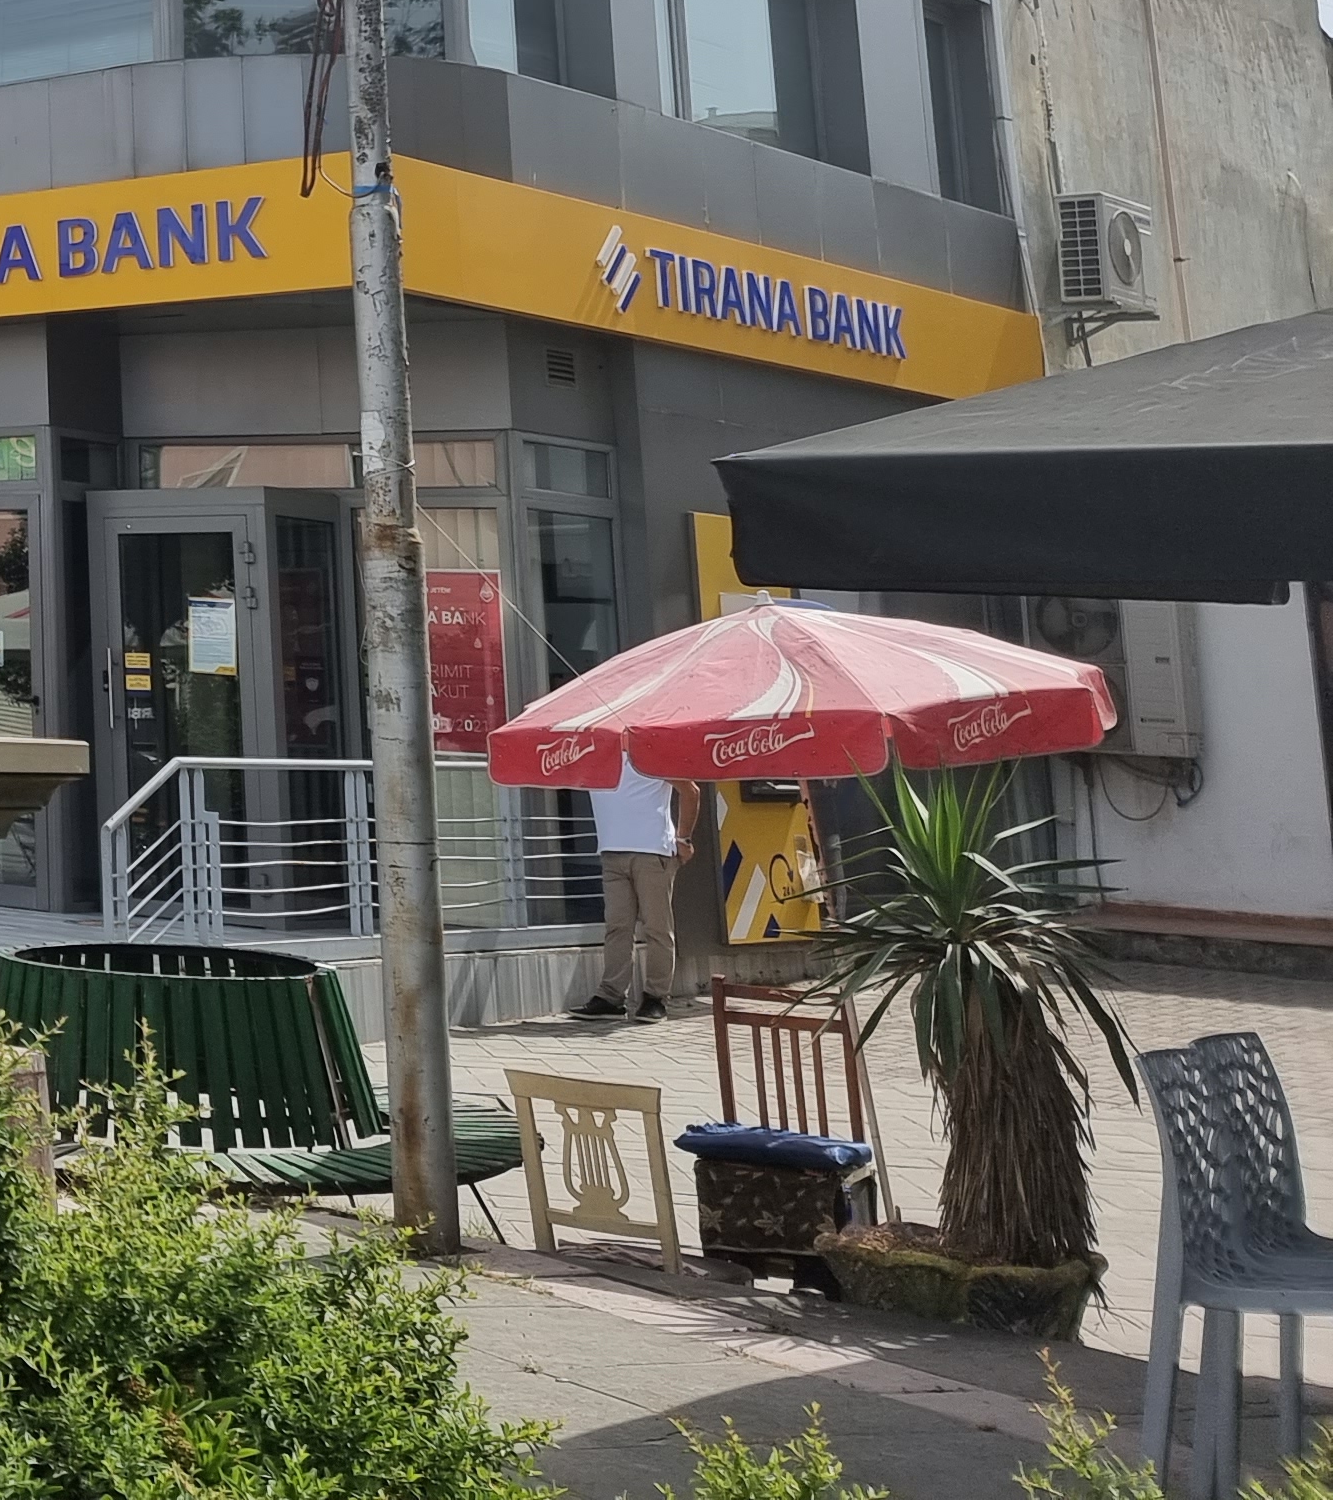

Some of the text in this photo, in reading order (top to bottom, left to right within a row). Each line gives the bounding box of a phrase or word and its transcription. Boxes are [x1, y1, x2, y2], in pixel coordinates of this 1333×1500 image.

[57, 196, 268, 279] BANK
[645, 247, 907, 360] TIRANA BANK
[441, 610, 486, 626] BANK
[430, 664, 474, 679] RIMIT
[430, 683, 470, 699] AKUT
[709, 722, 791, 768] Coca-Cola
[950, 701, 1015, 752] Coca-Cola
[539, 735, 591, 777] Coca-Cola
